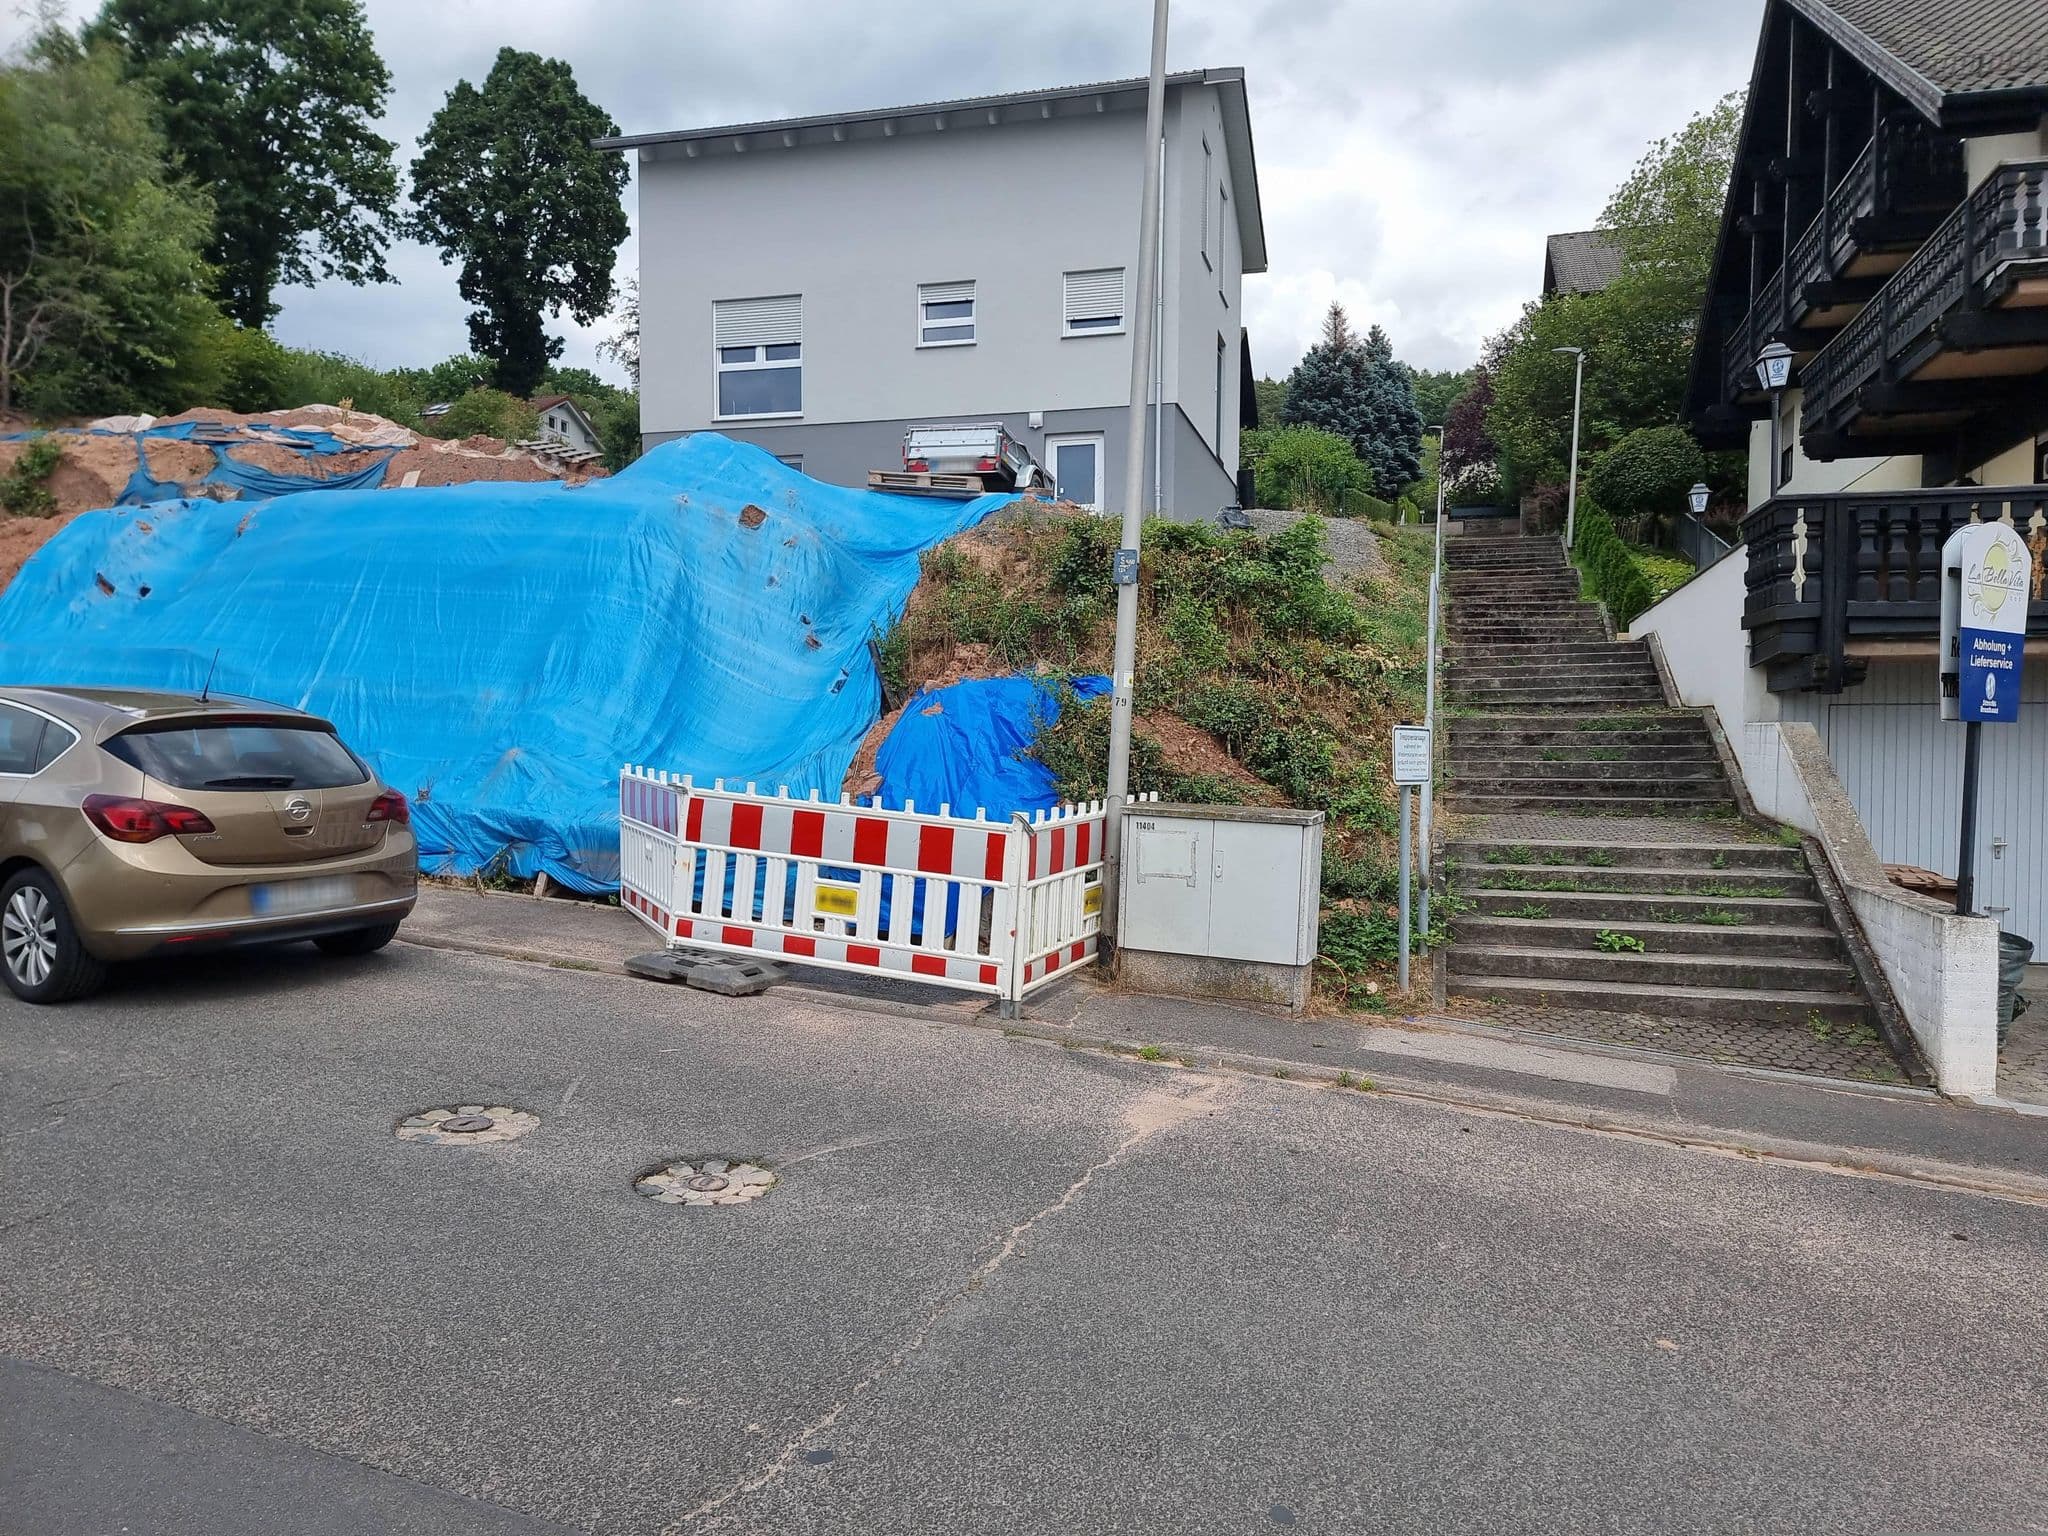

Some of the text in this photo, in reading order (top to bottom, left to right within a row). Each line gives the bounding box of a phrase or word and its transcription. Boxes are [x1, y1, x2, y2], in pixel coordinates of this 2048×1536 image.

[1967, 563, 2024, 588] La Bella Vita
[1973, 637, 2006, 655] Abholung
[1970, 654, 2013, 670] Lieferservice
[1115, 697, 1127, 707] 79
[1136, 821, 1155, 830] 11404
